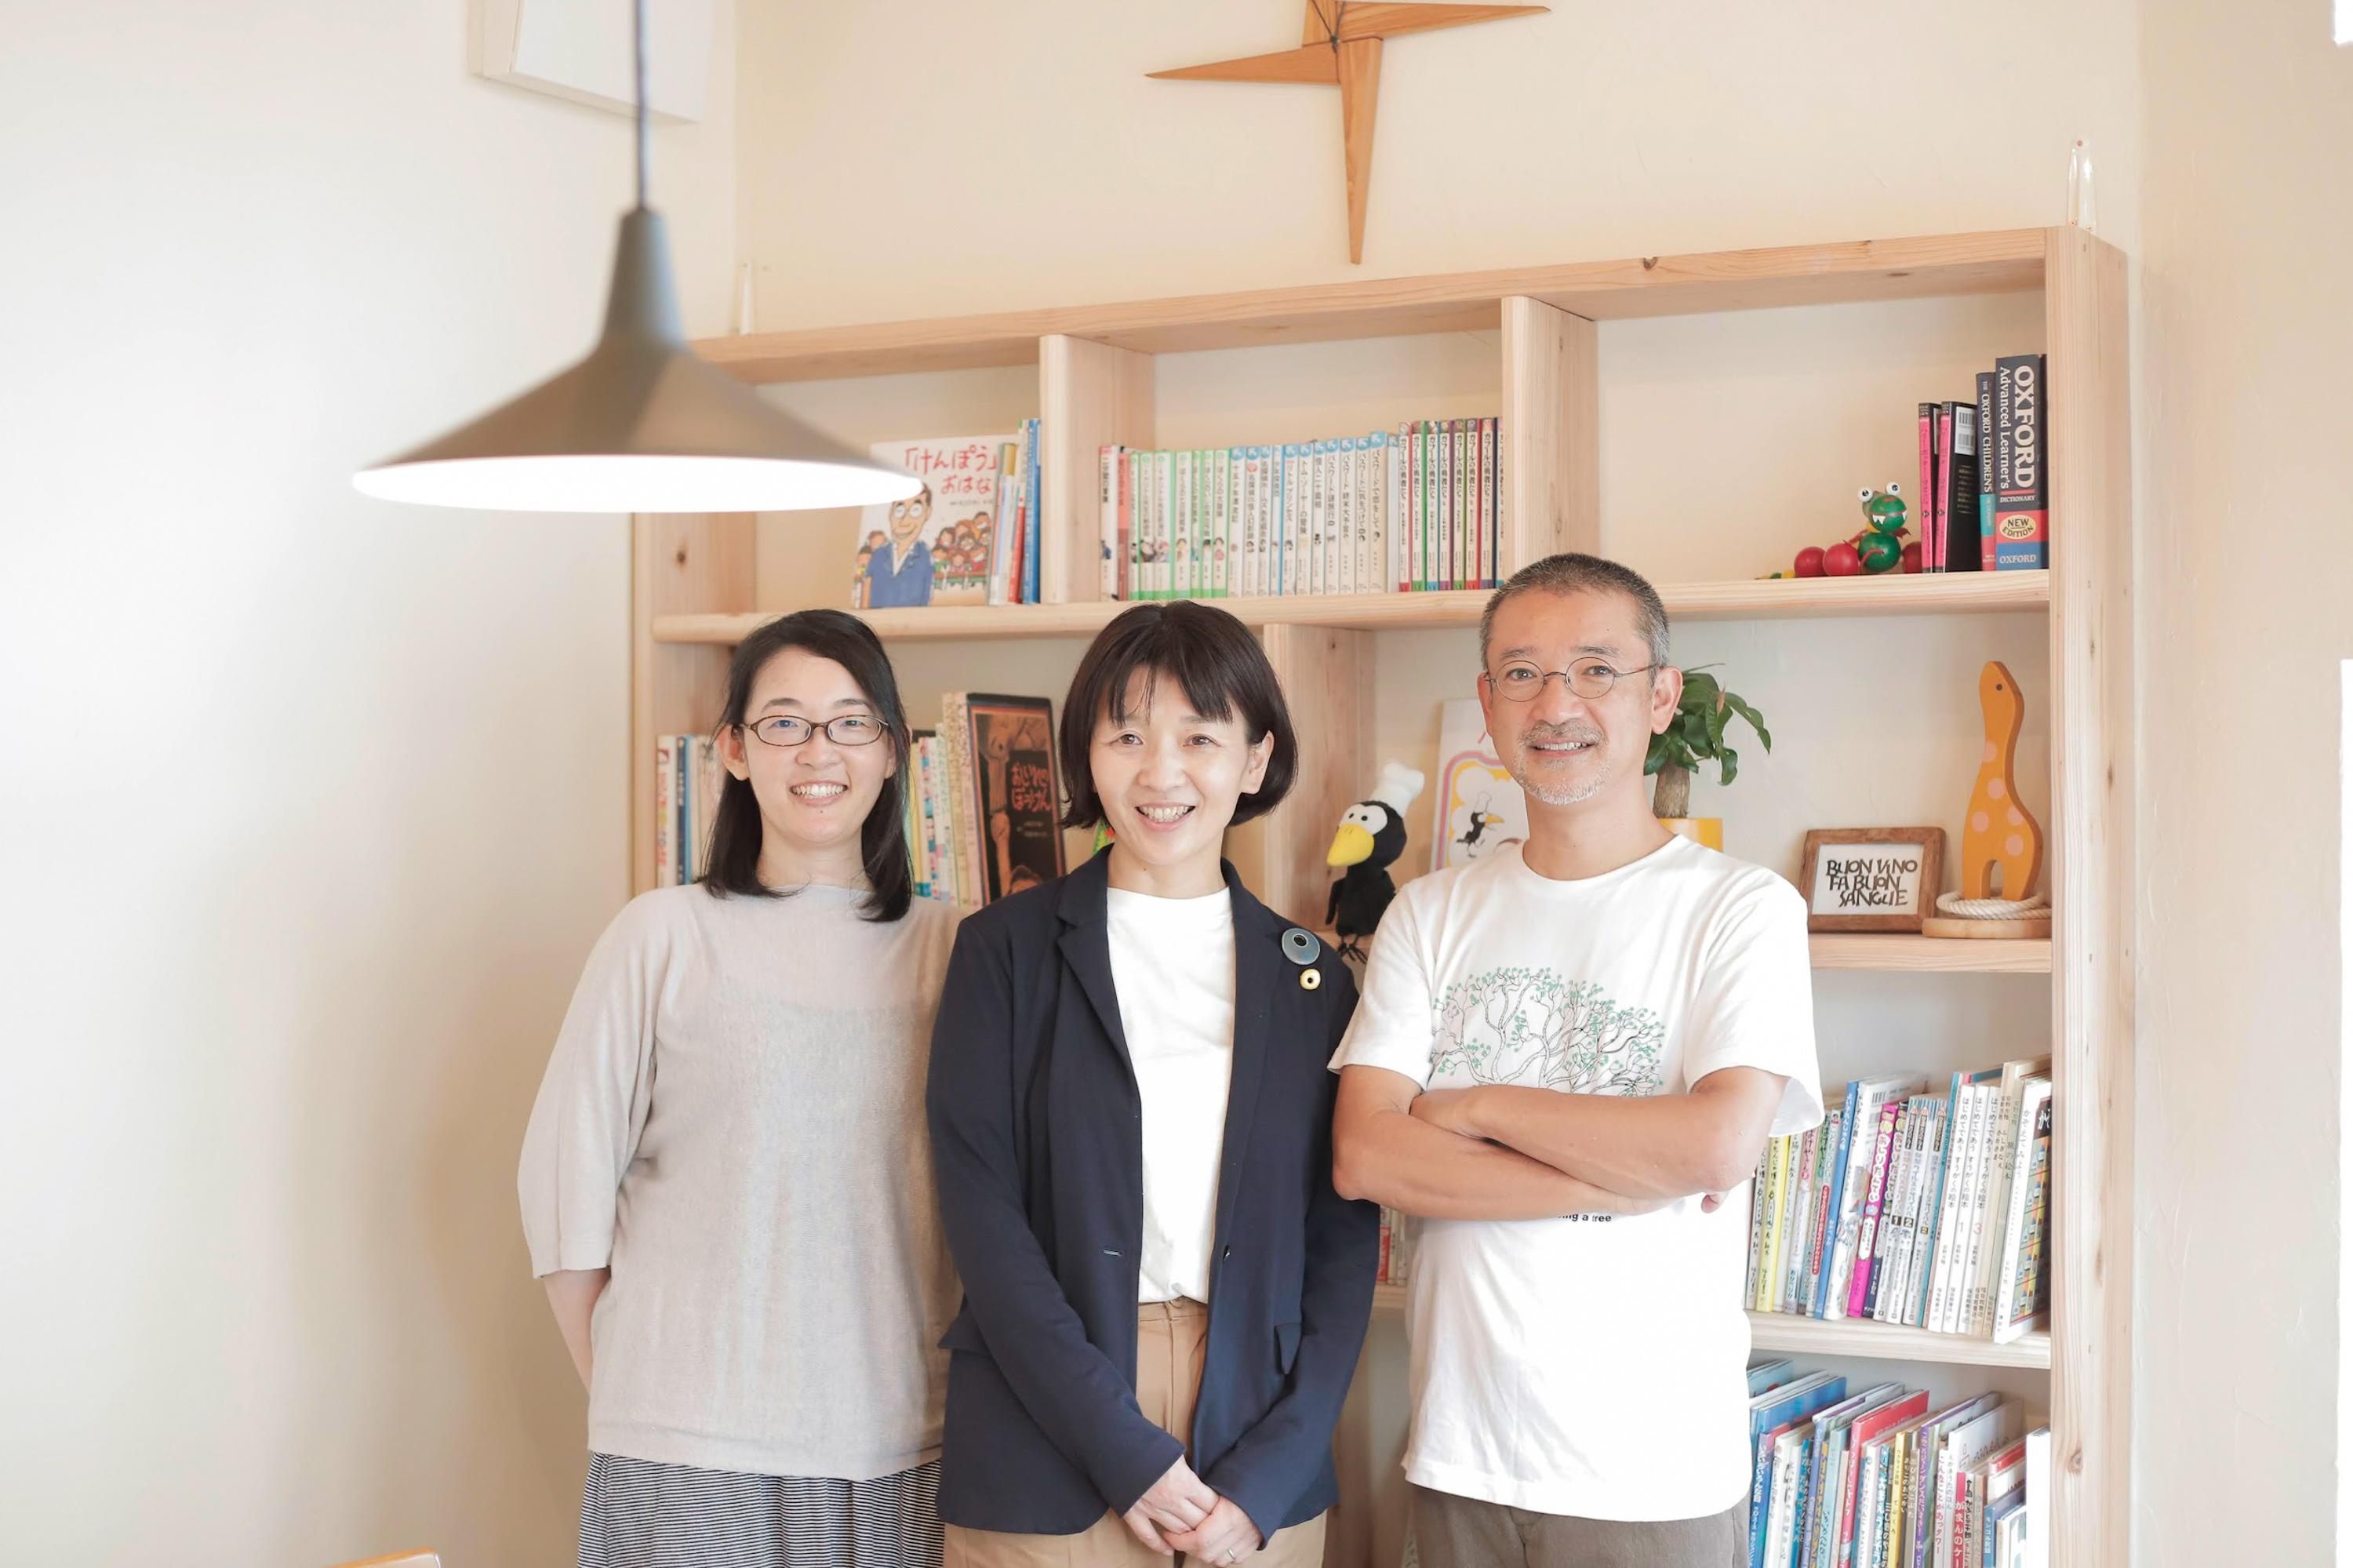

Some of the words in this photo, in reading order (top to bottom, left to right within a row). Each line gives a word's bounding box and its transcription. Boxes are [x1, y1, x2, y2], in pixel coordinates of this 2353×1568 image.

[1982, 394, 1991, 433] OXFORD
[2000, 366, 2011, 428] Advanced
[2014, 365, 2035, 488] OXFORD
[2000, 431, 2010, 489] Learner's
[2002, 526, 2034, 537] EDITION
[2008, 518, 2029, 526] NEW
[1999, 554, 2037, 563] OXFORD
[1826, 858, 1873, 876] BUON
[1877, 858, 1918, 875] VINO
[1829, 875, 1849, 890] FA
[1853, 874, 1900, 891] BUON
[1838, 890, 1908, 908] SANGUE
[1957, 1098, 1969, 1152] はじめてであう
[1970, 1098, 1982, 1151] はじめてであう
[1986, 1098, 1998, 1152] はじめてであう
[1869, 1135, 1889, 1202] おしりたんてい
[1947, 1157, 1961, 1208] すうがくの絵本
[1961, 1156, 1973, 1208] すうがくの絵本
[1977, 1157, 1989, 1209] すうがくの絵本
[1936, 1455, 1947, 1554] こんなことがあっタワー
[1954, 1501, 1966, 1568] がまんのケー
